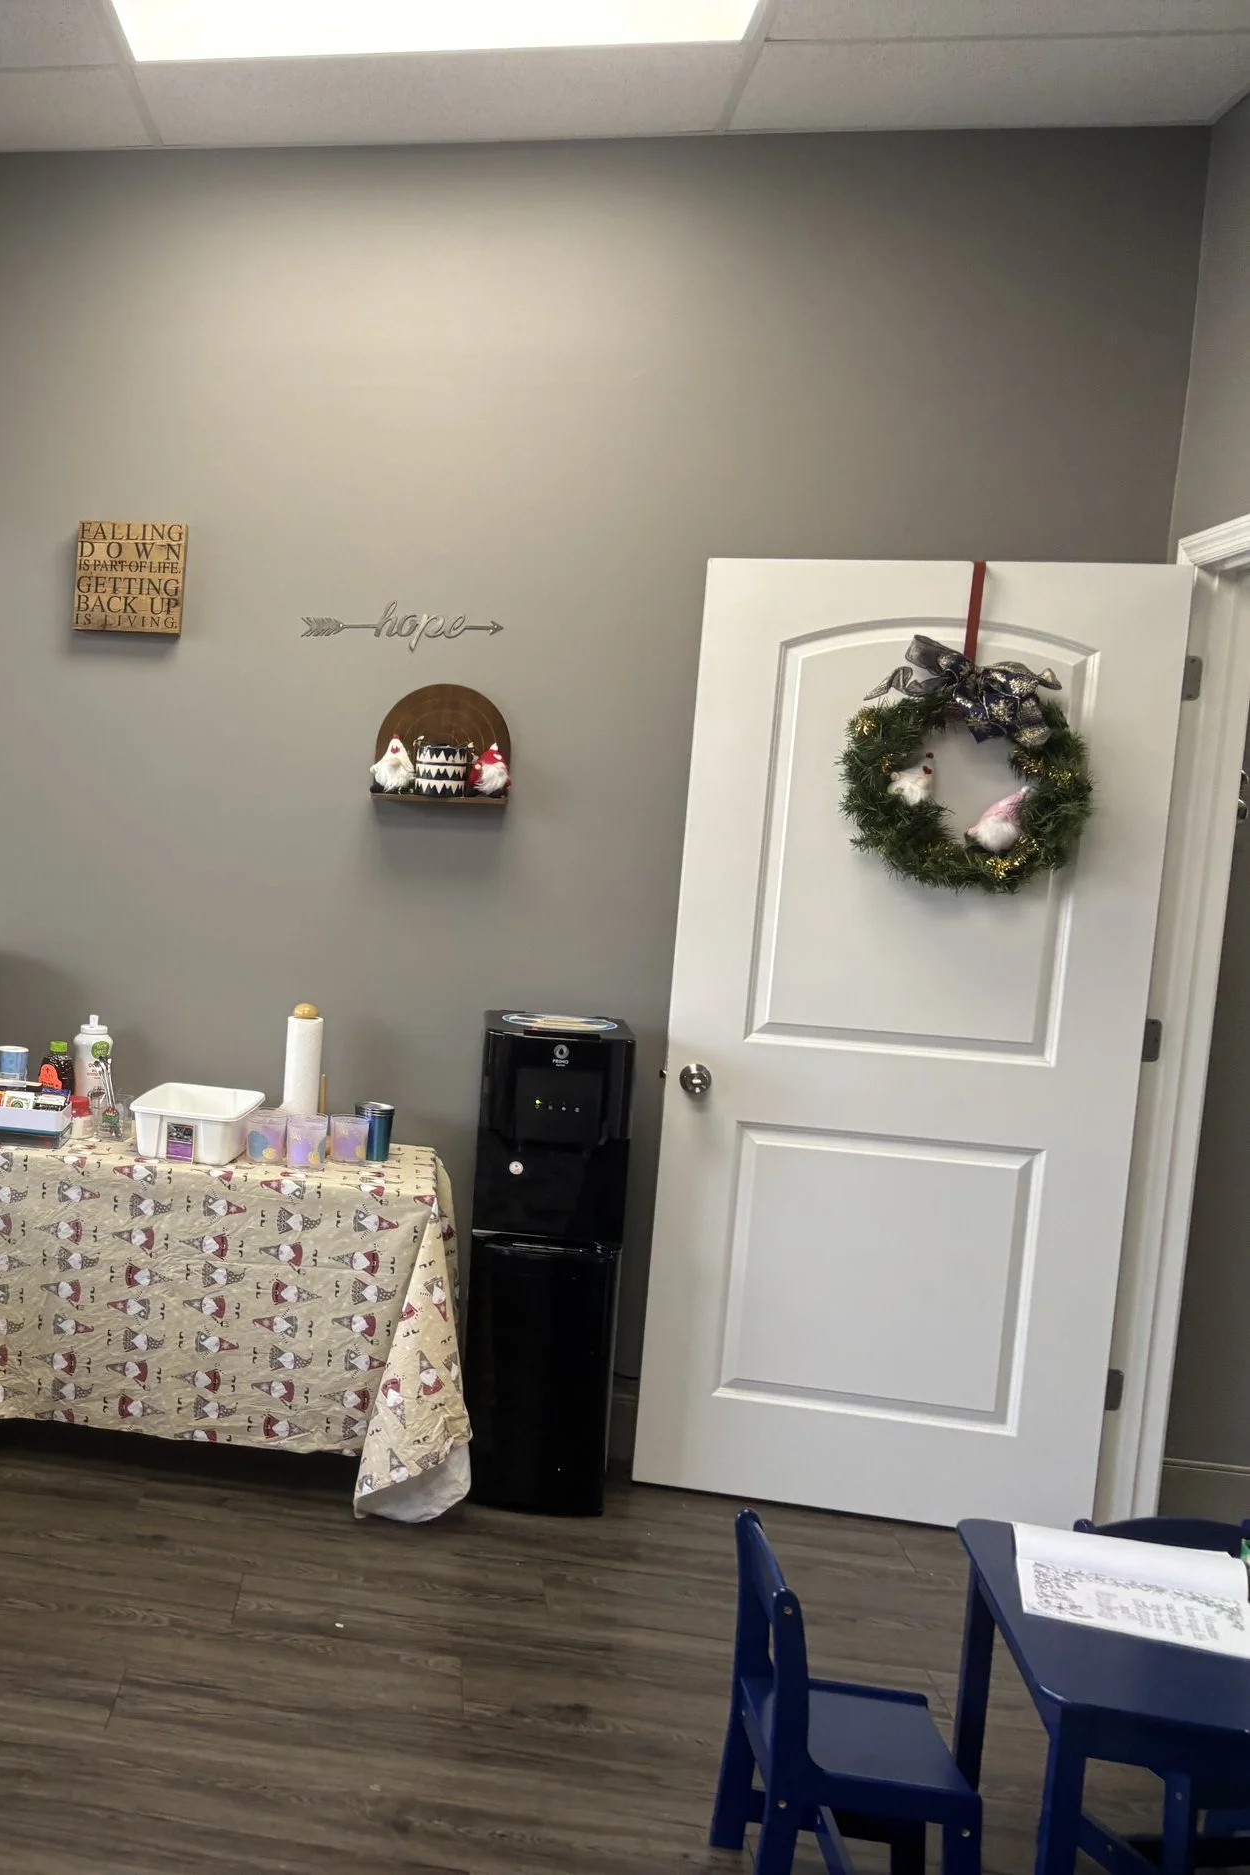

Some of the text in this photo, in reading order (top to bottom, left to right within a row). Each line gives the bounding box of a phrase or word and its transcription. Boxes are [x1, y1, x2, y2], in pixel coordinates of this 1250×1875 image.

[80, 522, 183, 542] FALLING
[78, 541, 182, 560] DOWN
[78, 559, 181, 574] IS PART OF LIFE.
[76, 575, 180, 597] GETTING
[76, 594, 179, 615] BACK UP
[75, 613, 178, 629] IS LIVING.
[374, 600, 465, 653] hope
